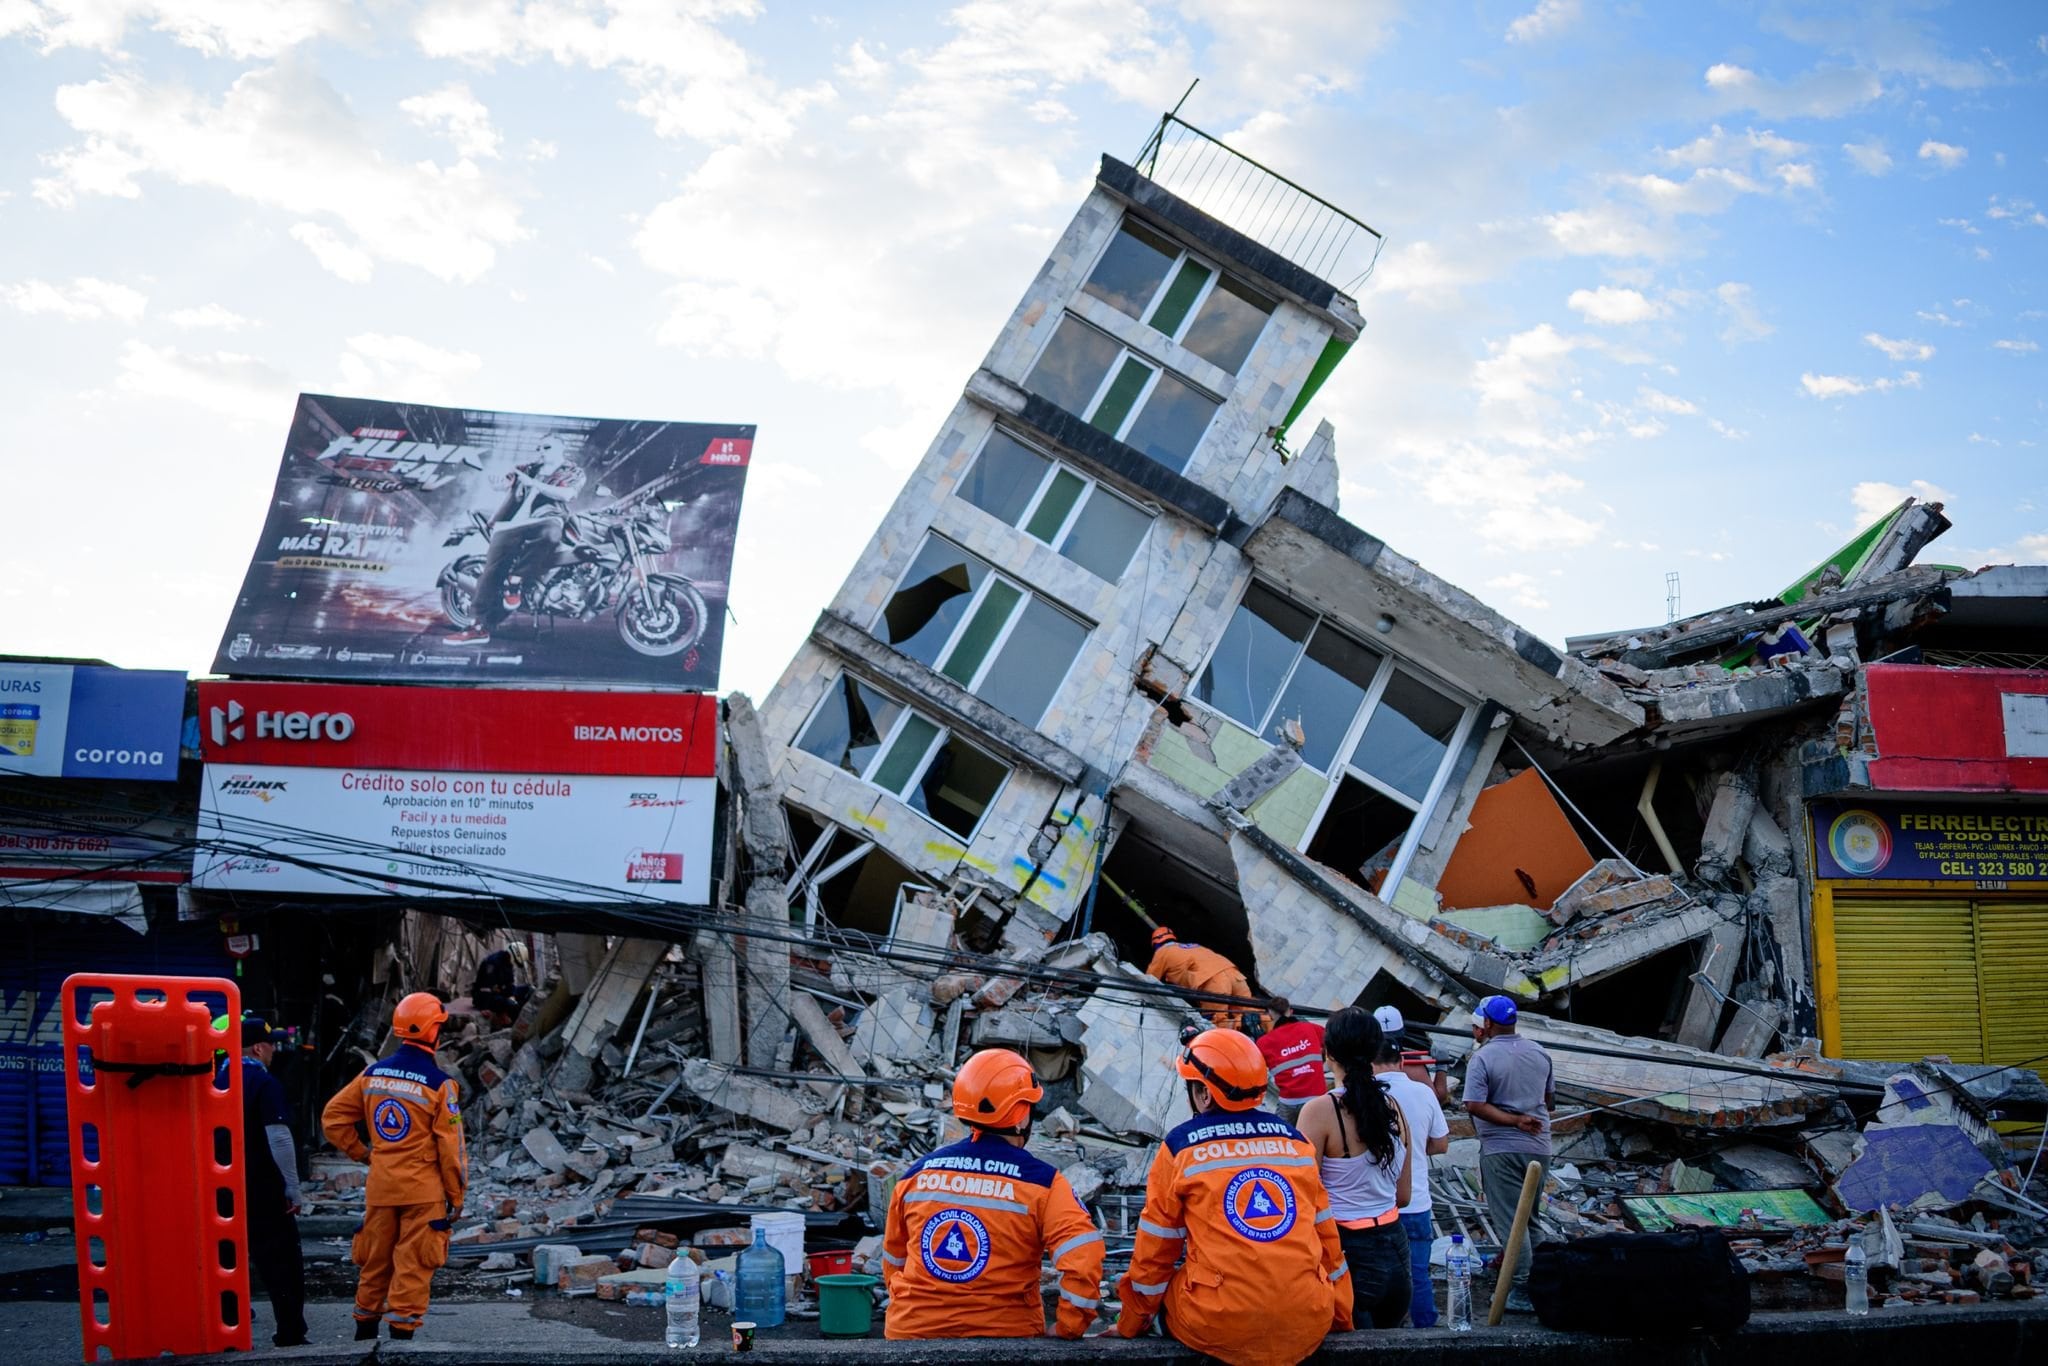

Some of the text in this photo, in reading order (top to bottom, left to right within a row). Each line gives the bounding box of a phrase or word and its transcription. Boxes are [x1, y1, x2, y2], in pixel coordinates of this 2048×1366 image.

[316, 435, 490, 471] HUNK
[710, 453, 741, 463] Hero
[328, 522, 404, 537] DEPORTIVA
[279, 534, 321, 551] MÁS
[324, 560, 348, 569] km/h
[0, 679, 41, 693] URAS
[256, 710, 355, 741] Hero
[574, 725, 683, 743] IBIZA MOTOS
[75, 748, 164, 766] corona
[219, 779, 288, 793] HUNK
[342, 772, 571, 797] Crédito solo con tu cédula
[383, 794, 447, 808] Aprobación
[450, 799, 464, 808] en
[489, 798, 534, 810] minutos
[400, 810, 507, 825] Facil y a tu medida
[1900, 814, 2048, 832] FERRELECTR
[391, 826, 507, 841] Repuestos Genuinos
[1943, 832, 1993, 841] TODO
[1998, 833, 2022, 841] EN
[26, 836, 48, 849] 310
[52, 838, 74, 850] 375
[398, 841, 506, 856] Taller especializado
[1914, 842, 1935, 850] TEJAS
[641, 856, 666, 867] AÑOS
[1940, 862, 2048, 875] CEL: 323 580 2
[632, 869, 666, 879] Hero
[1281, 1042, 1306, 1056] Claro
[373, 1068, 428, 1084] DEFENSA CIVIL
[369, 1078, 423, 1096] COLOMBIA
[1187, 1122, 1293, 1144] DEFENSA CIVIL
[1192, 1140, 1299, 1162] COLOMBIA
[923, 1157, 1022, 1177] DEFENSA CIVIL
[916, 1173, 1015, 1200] COLOMBIA
[1226, 1169, 1294, 1215] DEFENSA CIVIL COLOMBIANA
[922, 1210, 989, 1257] DEFENSA CIVIL COLOMBIANA
[949, 1241, 961, 1249] DC
